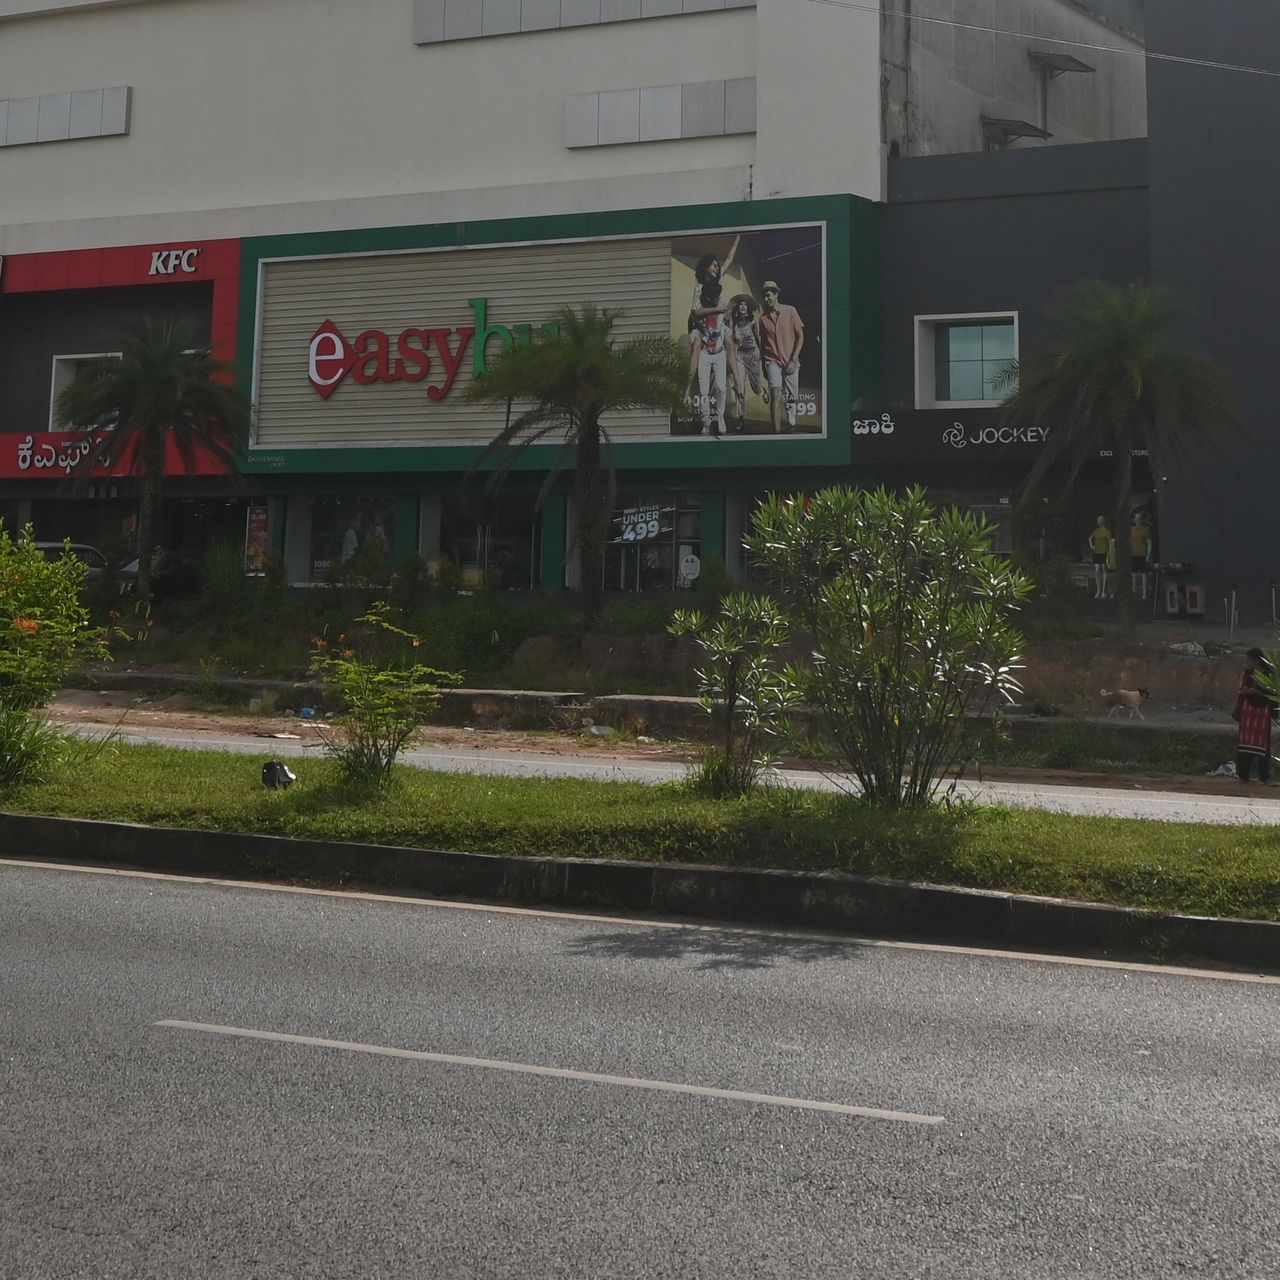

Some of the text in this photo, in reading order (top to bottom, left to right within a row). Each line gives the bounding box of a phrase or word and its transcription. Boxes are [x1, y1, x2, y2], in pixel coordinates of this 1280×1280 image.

[148, 248, 202, 275] KFC
[308, 297, 612, 401] easyb
[853, 413, 895, 434] ಜಾಕಿ
[970, 426, 1050, 444] JOCKEY
[623, 511, 659, 524] UNDER
